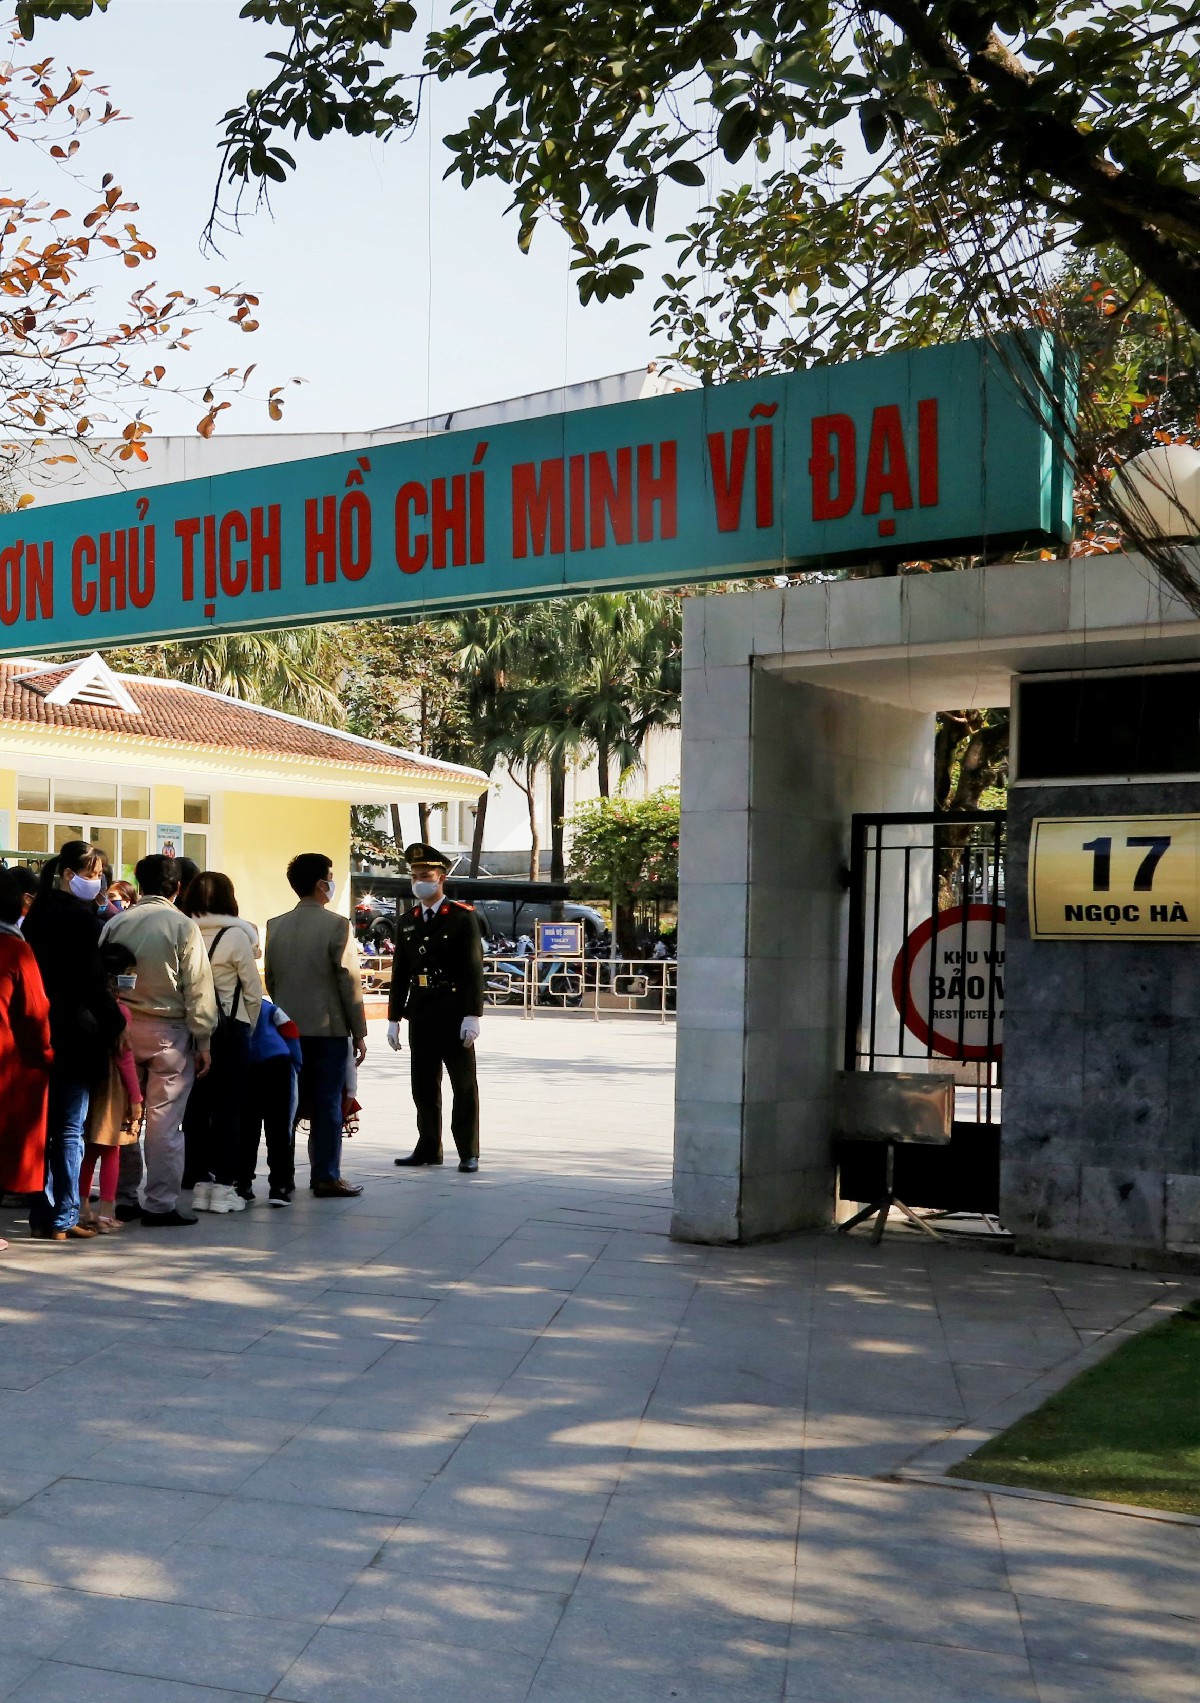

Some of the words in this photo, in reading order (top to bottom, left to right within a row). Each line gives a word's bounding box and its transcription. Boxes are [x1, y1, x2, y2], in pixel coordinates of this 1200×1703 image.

[71, 497, 156, 617] CHỦ
[174, 504, 282, 617] TỊCH
[304, 456, 372, 585] HỒ
[395, 441, 489, 574] CHÍ
[512, 440, 678, 559] MINH
[707, 402, 779, 533] VĨ
[808, 398, 939, 537] ĐẠI
[1082, 836, 1171, 891] 17
[1064, 904, 1140, 925] NGỌC
[1150, 901, 1189, 922] HÀ
[930, 968, 985, 1000] BẢO
[931, 1010, 996, 1019] RESTICTE
